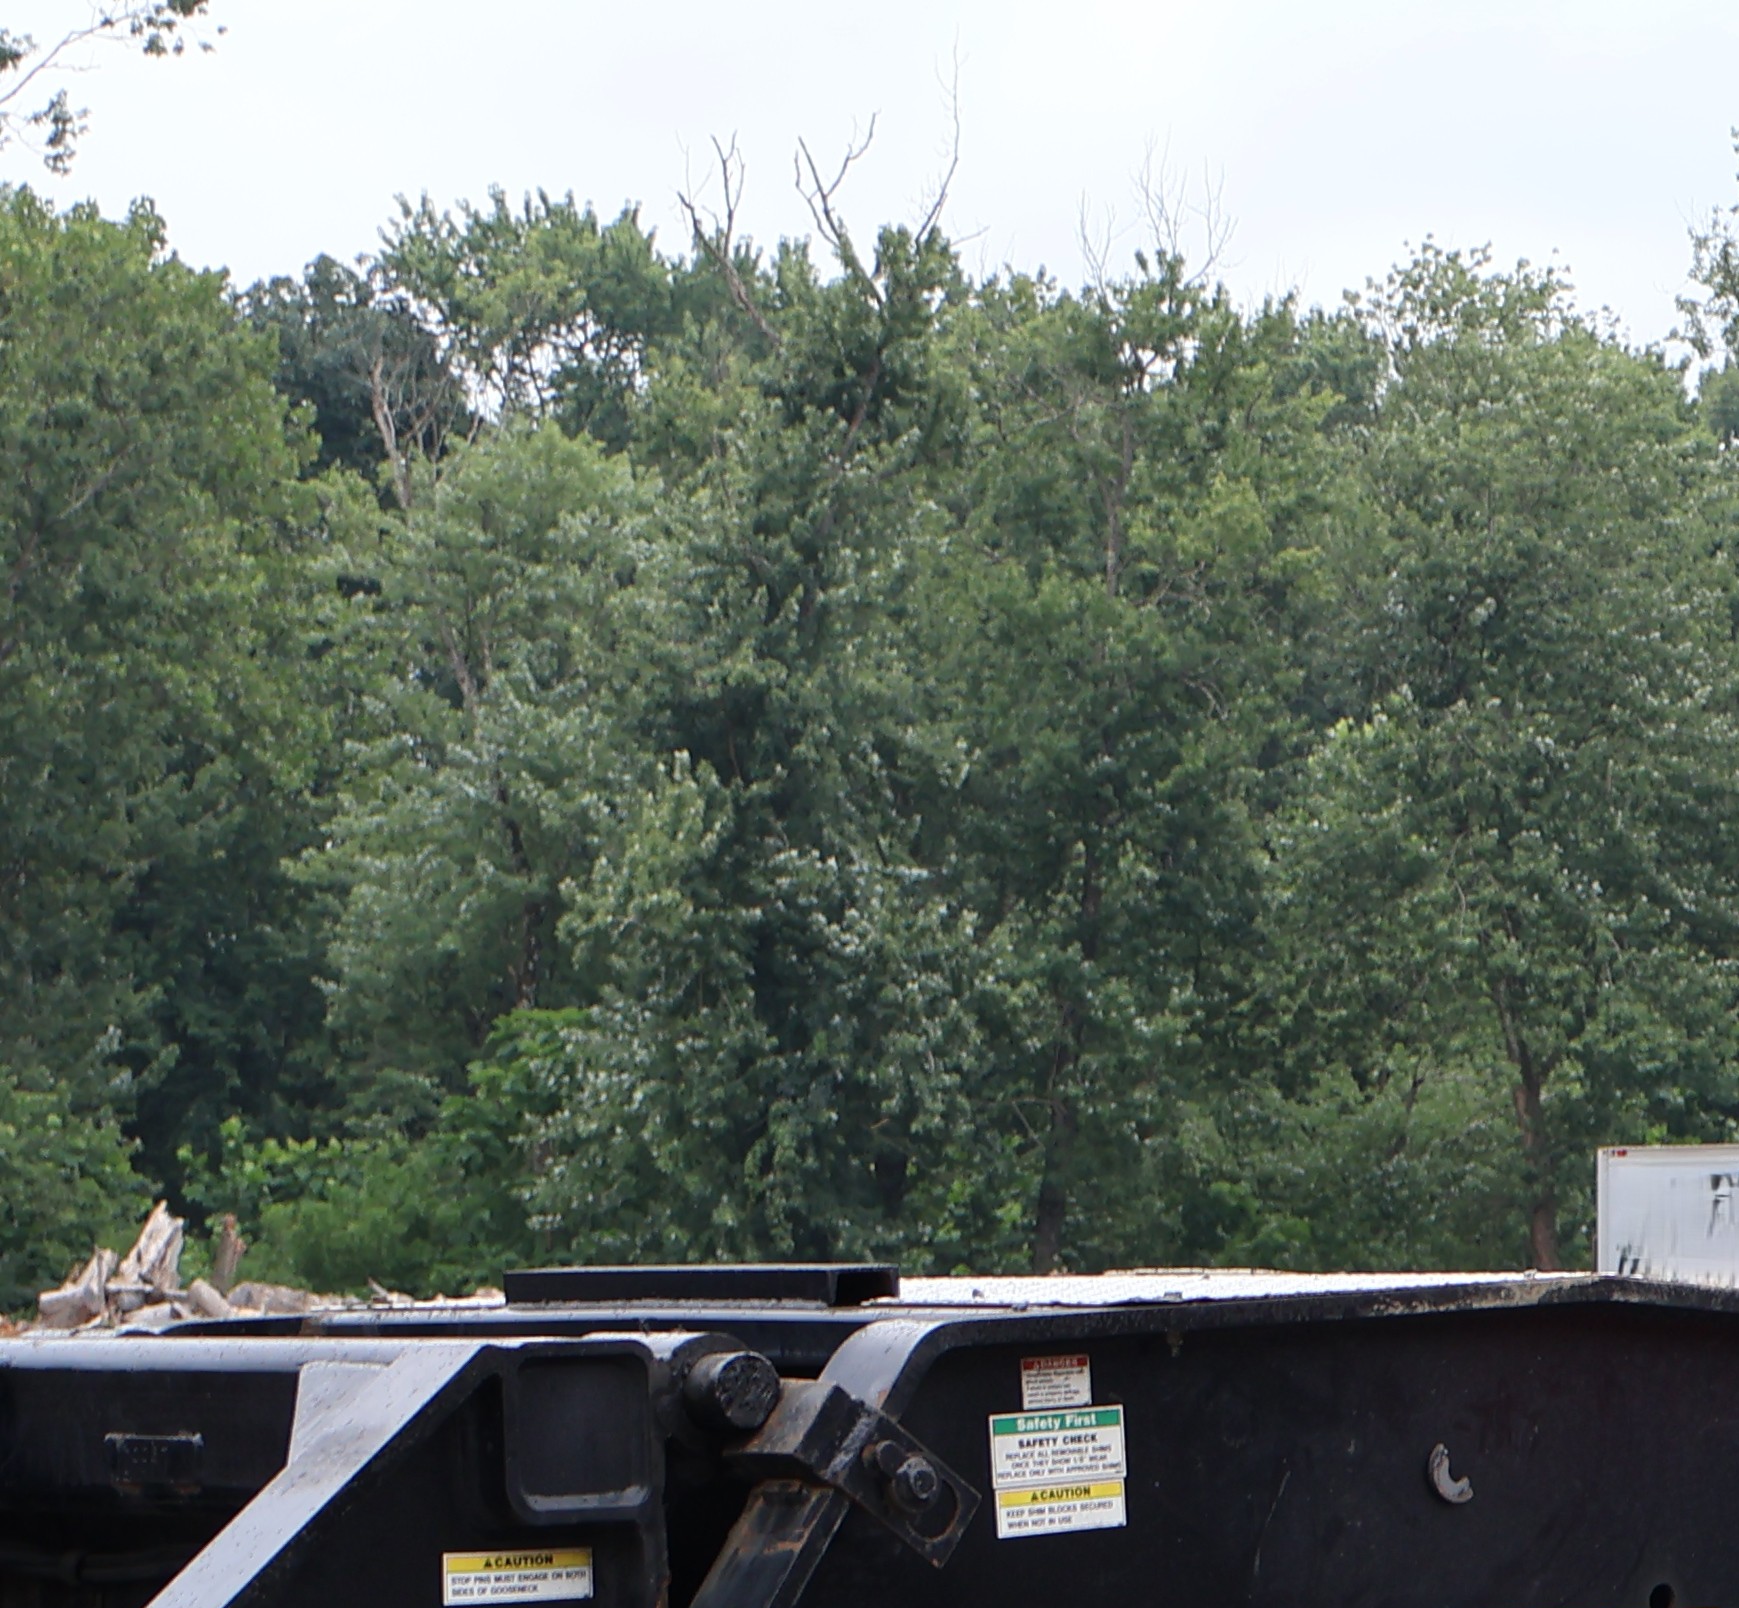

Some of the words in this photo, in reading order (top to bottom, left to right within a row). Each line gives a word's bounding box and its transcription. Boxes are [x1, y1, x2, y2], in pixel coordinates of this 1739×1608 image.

[1017, 1416, 1061, 1432] Safety
[1066, 1412, 1097, 1428] First
[1018, 1436, 1059, 1449] SAFETY
[1062, 1433, 1098, 1446] CHECK
[1040, 1485, 1092, 1500] CAUTION
[1006, 1508, 1025, 1518] KEEP
[1048, 1504, 1078, 1515] BLOCKS
[1080, 1500, 1114, 1511] SECURED
[1007, 1519, 1029, 1530] WHEN
[1031, 1518, 1046, 1528] NOT
[1048, 1517, 1056, 1526] IN
[1058, 1515, 1073, 1525] USE
[494, 1553, 554, 1568] CAUTION
[451, 1576, 472, 1586] STOP
[494, 1573, 516, 1583] MUST
[518, 1572, 549, 1583] ENGAGE
[551, 1571, 563, 1581] ON
[565, 1570, 587, 1581] BOTH
[451, 1587, 475, 1597] SIDES
[477, 1586, 488, 1596] OF
[490, 1584, 539, 1596] GOOSENECK
